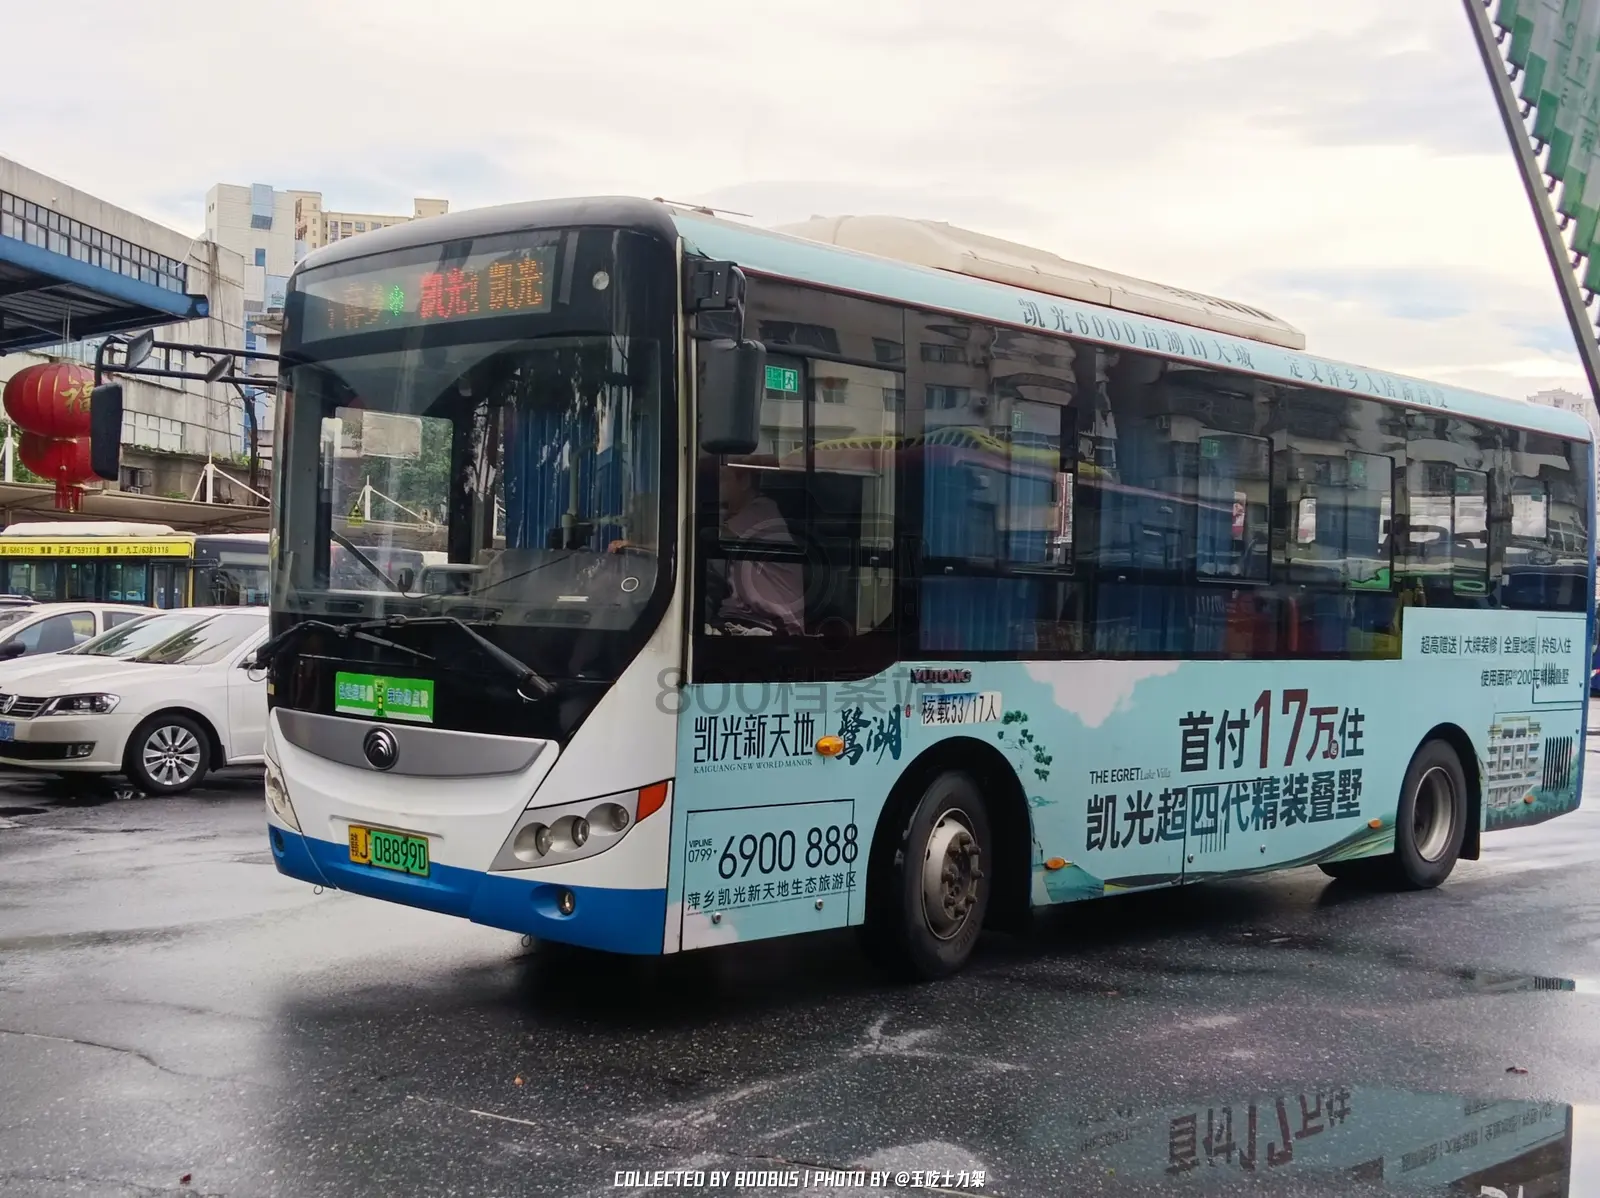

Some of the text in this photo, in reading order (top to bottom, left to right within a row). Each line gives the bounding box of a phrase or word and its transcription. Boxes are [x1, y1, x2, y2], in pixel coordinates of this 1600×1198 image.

[911, 668, 971, 683] YUTONG
[921, 694, 997, 724] 核载53/17人
[694, 711, 815, 764] 凯光新天地
[693, 758, 812, 774] KAIGUANG NEW WORLD MANOR
[1089, 770, 1109, 784] THE
[1111, 767, 1141, 782] EGRET
[1086, 768, 1362, 852] 凯光超四代精装叠墅
[689, 838, 713, 848] VIPLINE
[718, 830, 796, 879] 6900
[805, 823, 858, 868] 888
[687, 871, 857, 911] 萍乡凯光新天地生态旅游区
